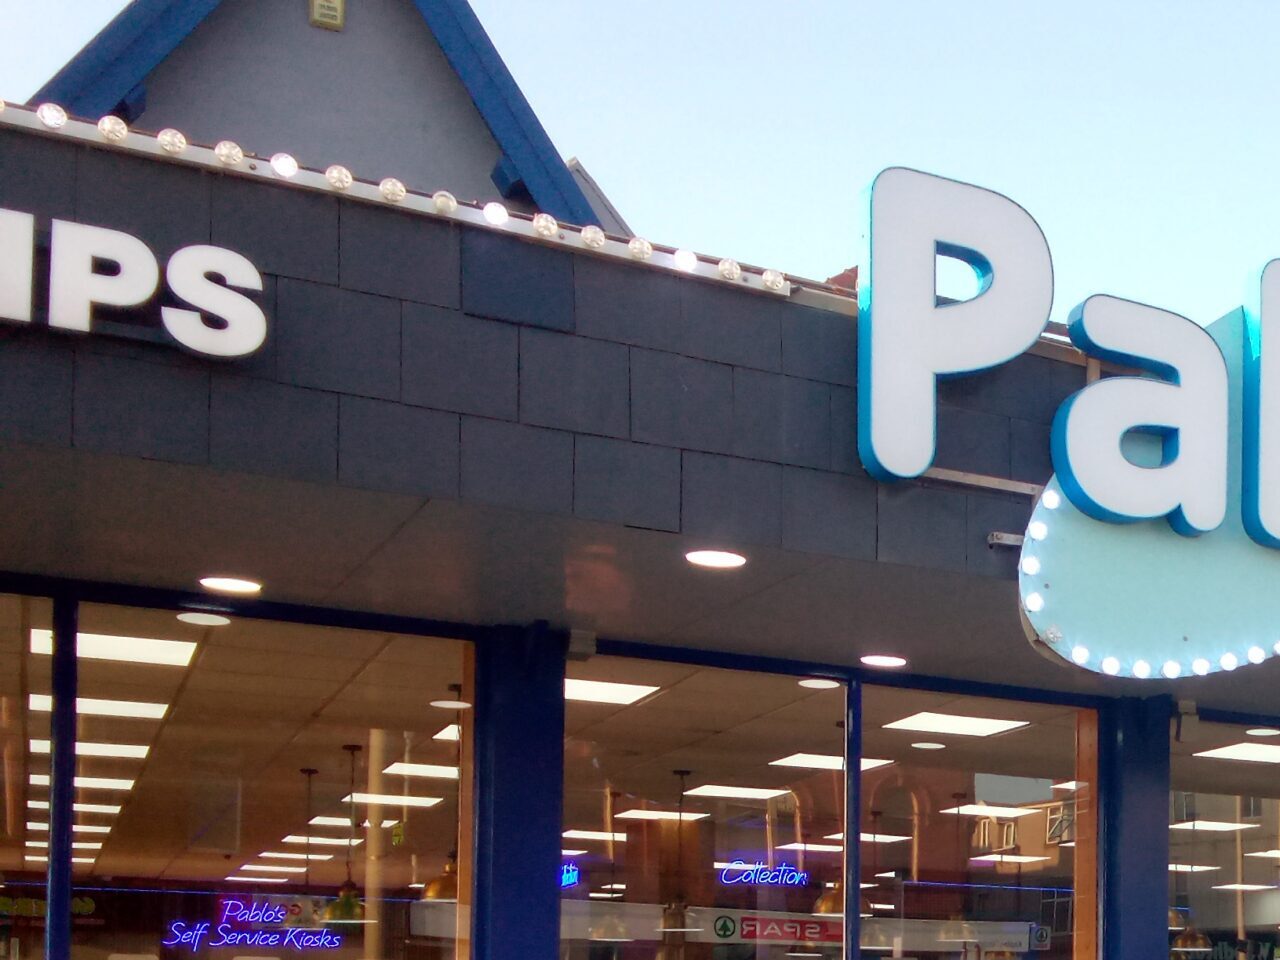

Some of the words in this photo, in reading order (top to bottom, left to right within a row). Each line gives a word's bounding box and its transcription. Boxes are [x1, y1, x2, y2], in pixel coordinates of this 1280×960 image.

[222, 900, 287, 924] Pablo's
[209, 923, 280, 947] Service
[282, 929, 343, 950] Kiosks
